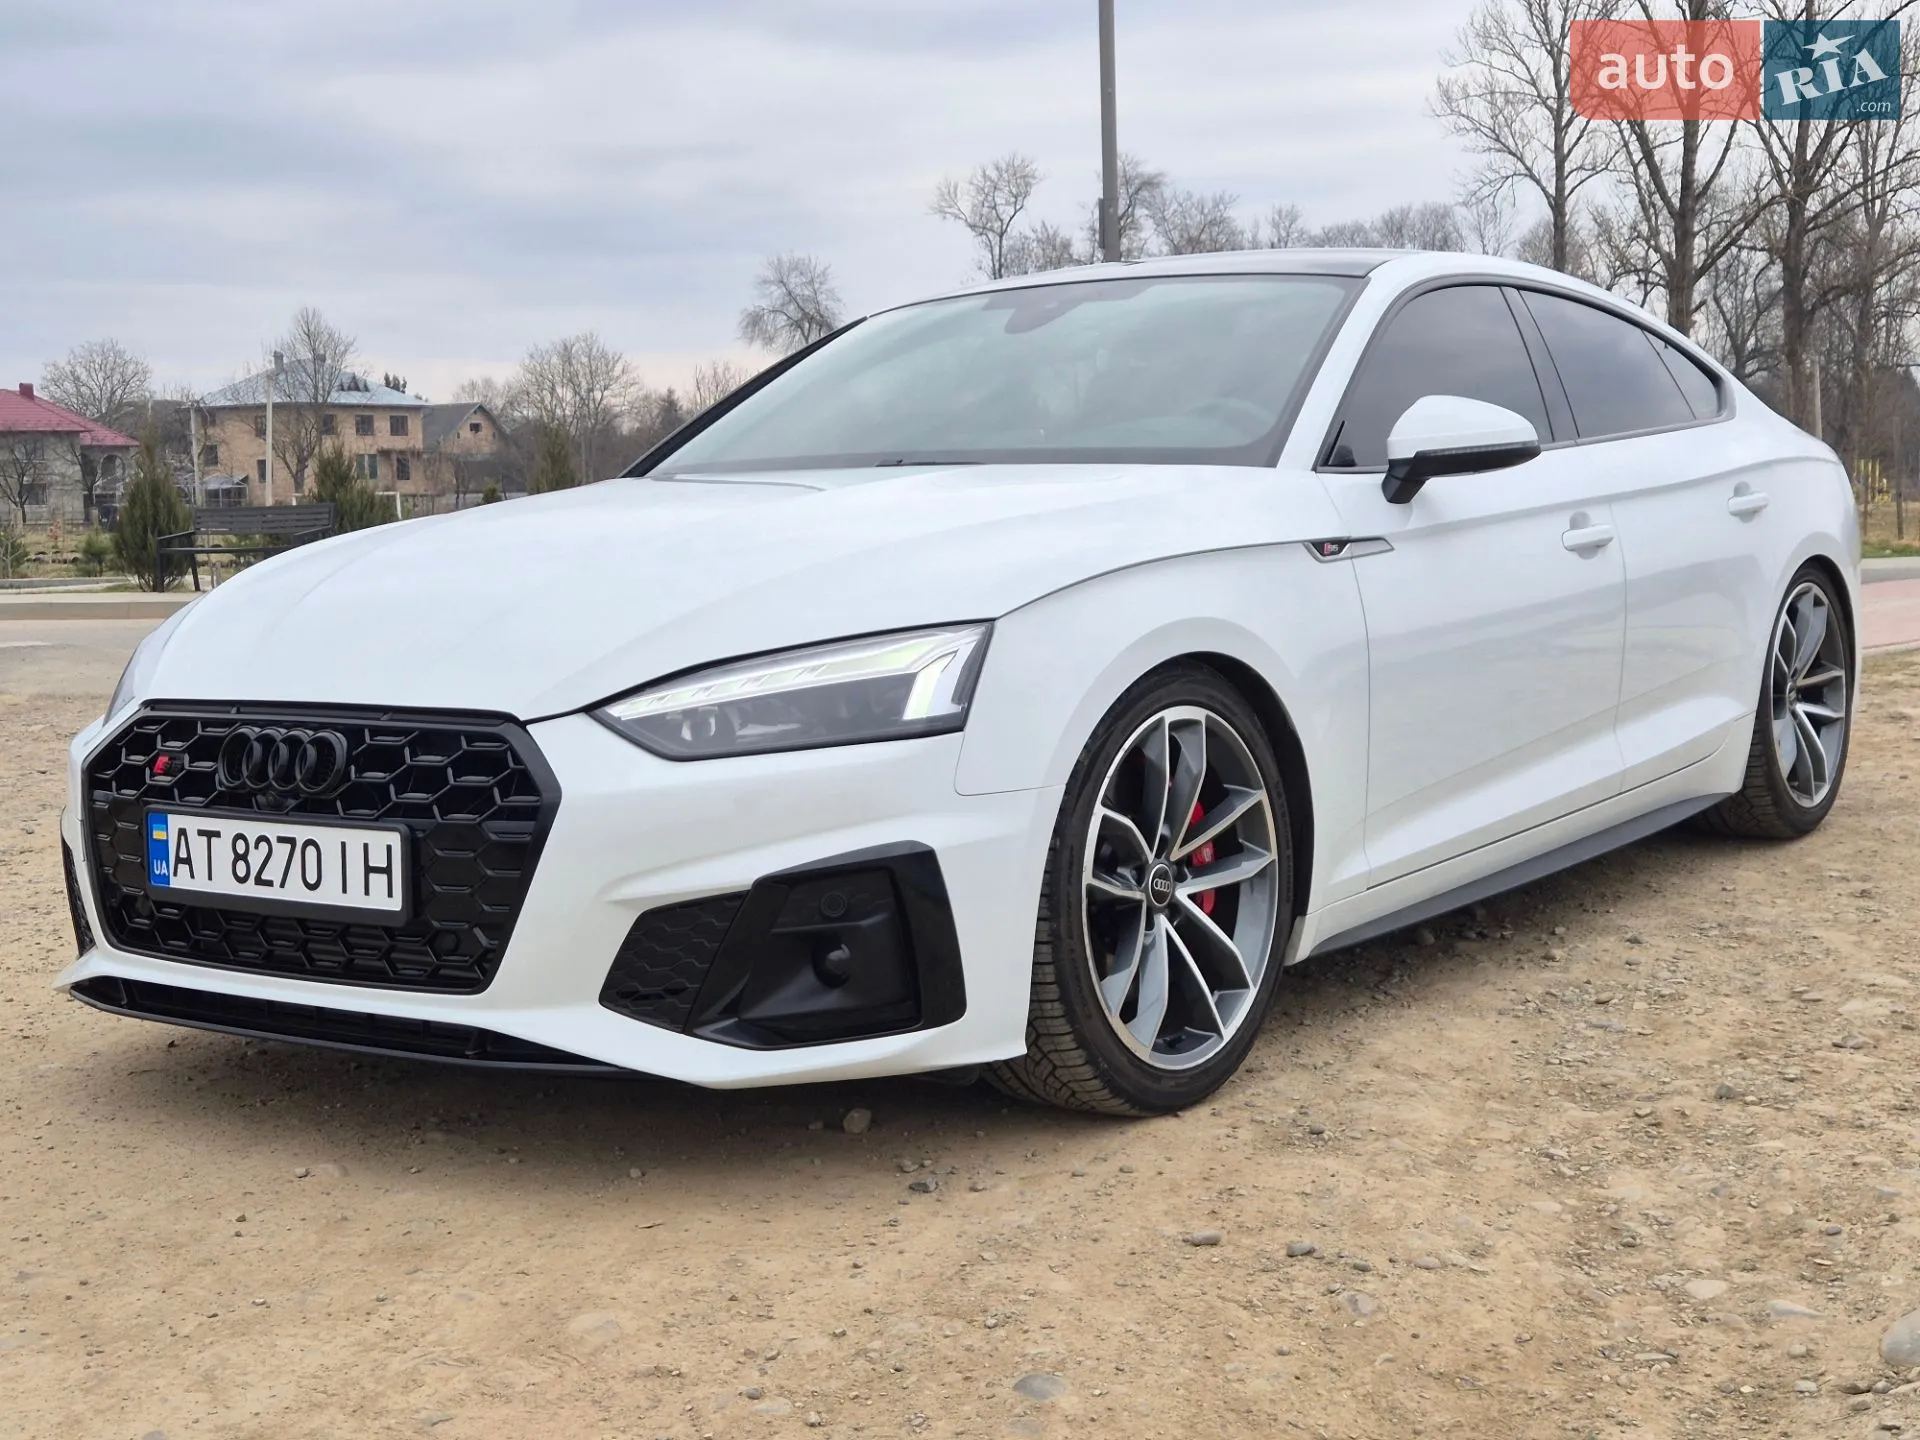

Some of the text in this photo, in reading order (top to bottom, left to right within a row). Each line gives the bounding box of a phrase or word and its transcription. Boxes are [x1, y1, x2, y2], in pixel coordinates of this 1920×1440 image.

[153, 859, 168, 876] UA
[173, 827, 393, 898] AT 8270 IH
